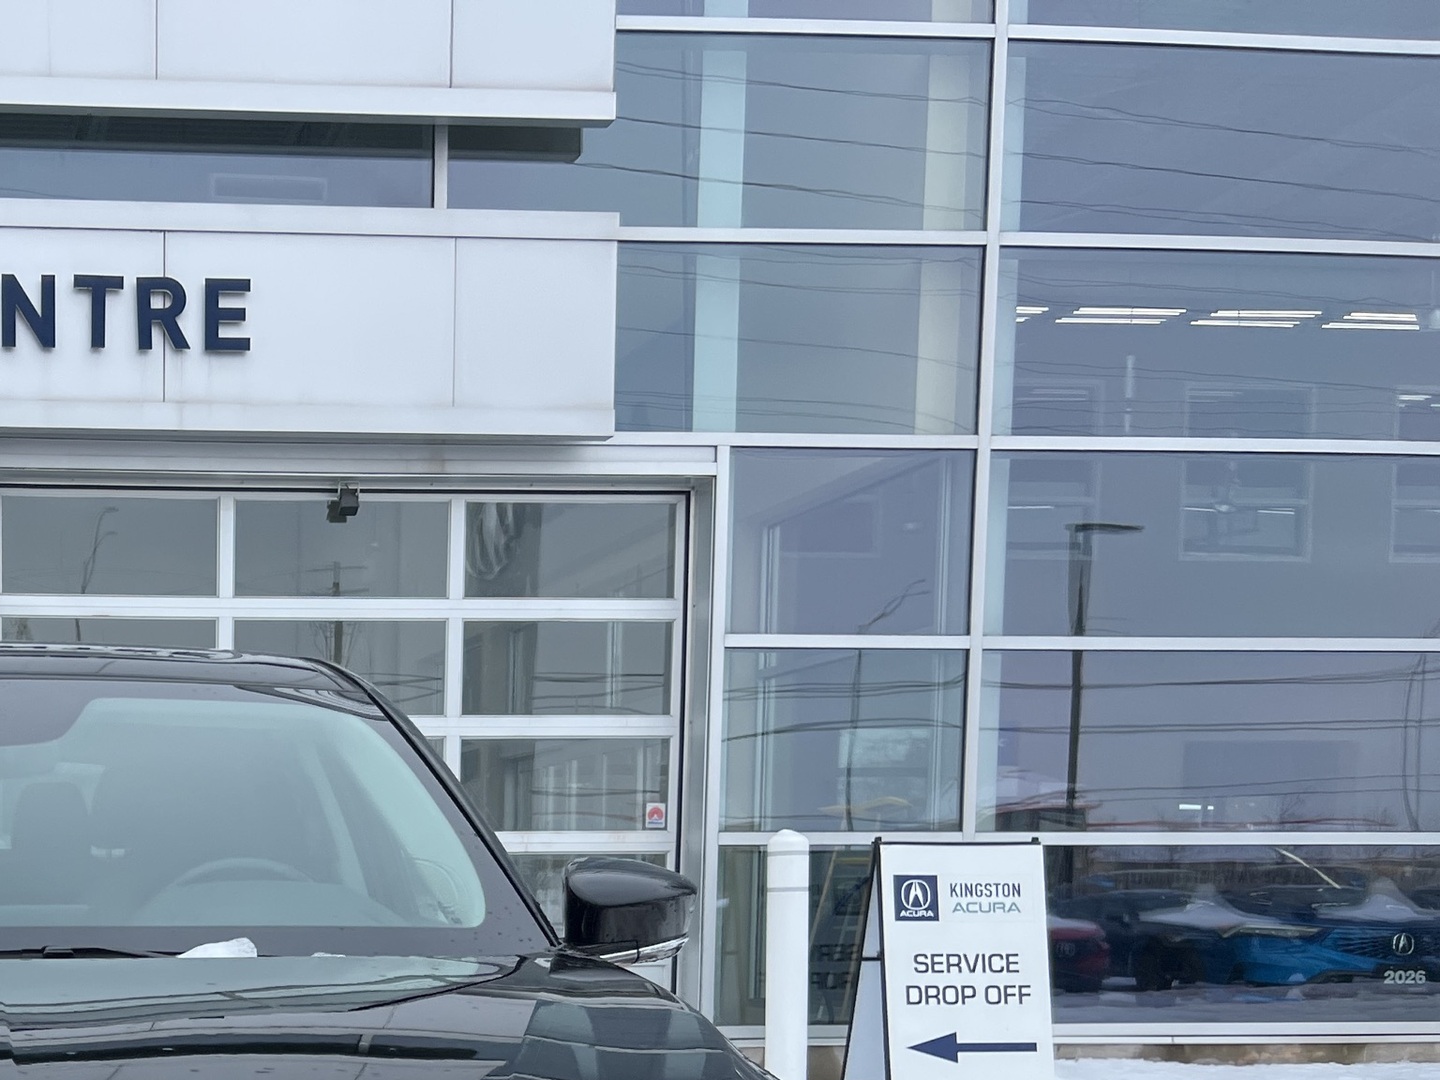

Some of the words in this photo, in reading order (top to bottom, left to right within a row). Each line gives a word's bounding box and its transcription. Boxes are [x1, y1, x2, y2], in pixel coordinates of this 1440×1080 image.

[949, 882, 1022, 899] KINGSTON
[899, 909, 935, 918] ACURA
[951, 901, 1022, 914] ACURA
[913, 953, 1020, 974] SERVICE
[1383, 969, 1427, 985] 2026
[905, 985, 977, 1006] DROP
[984, 984, 1032, 1005] OFF
